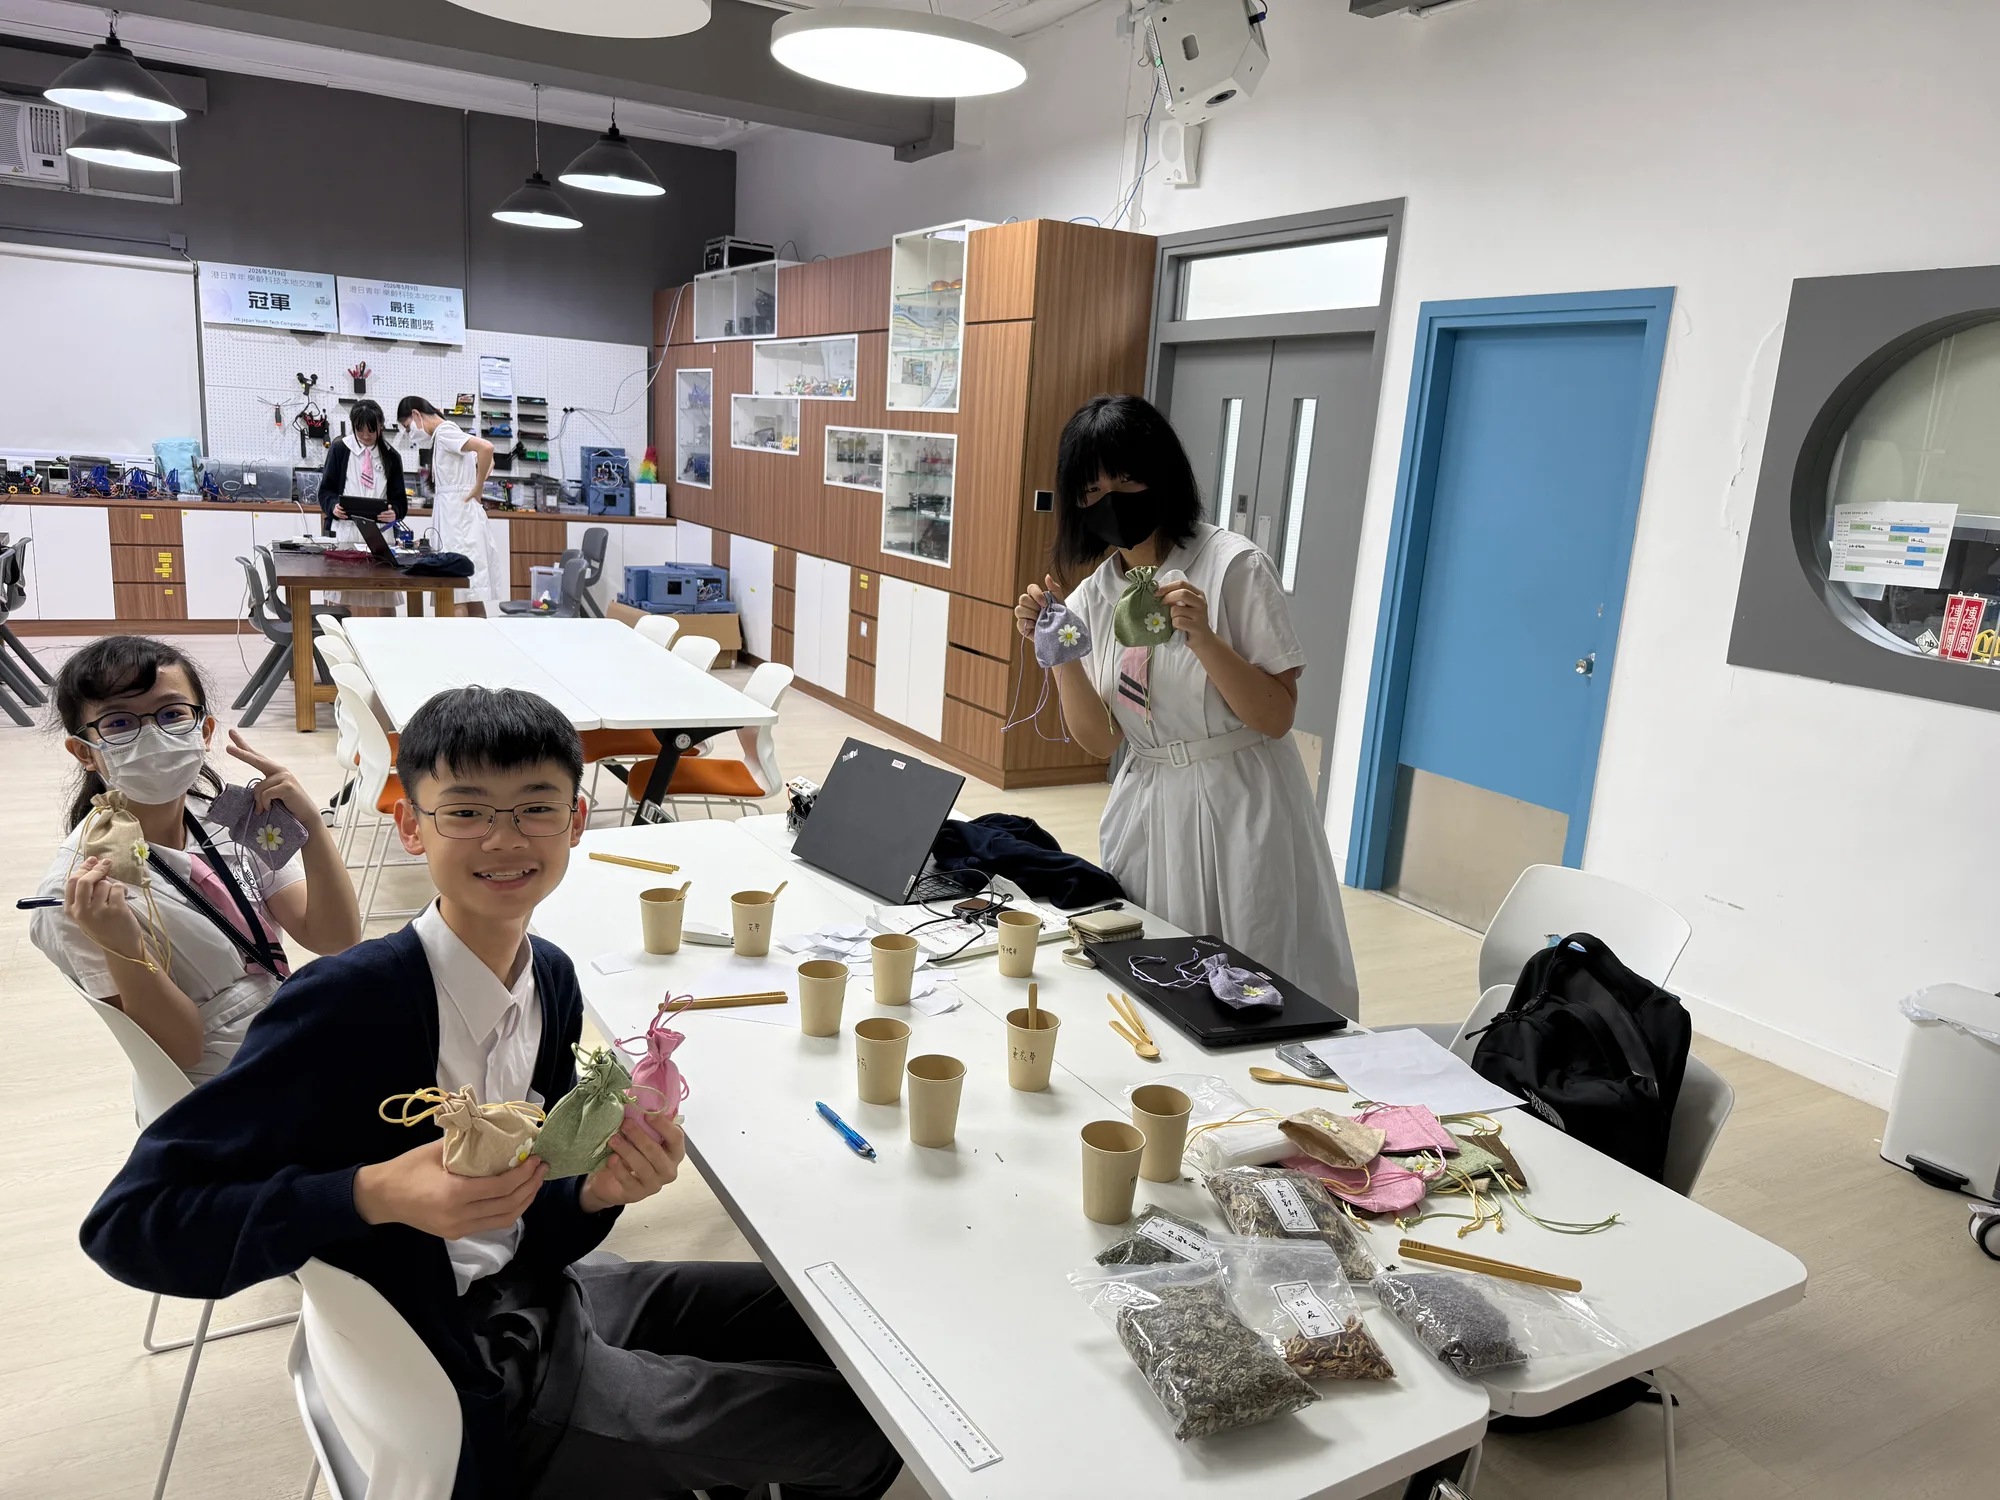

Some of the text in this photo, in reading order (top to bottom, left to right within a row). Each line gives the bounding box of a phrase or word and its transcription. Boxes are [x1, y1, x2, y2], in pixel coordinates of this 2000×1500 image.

[211, 270, 246, 280] 港日青年
[248, 267, 287, 277] 2026年5月9日
[383, 282, 419, 292] 2026年5月9日
[248, 290, 291, 312] 冠軍
[390, 301, 415, 315] 最佳
